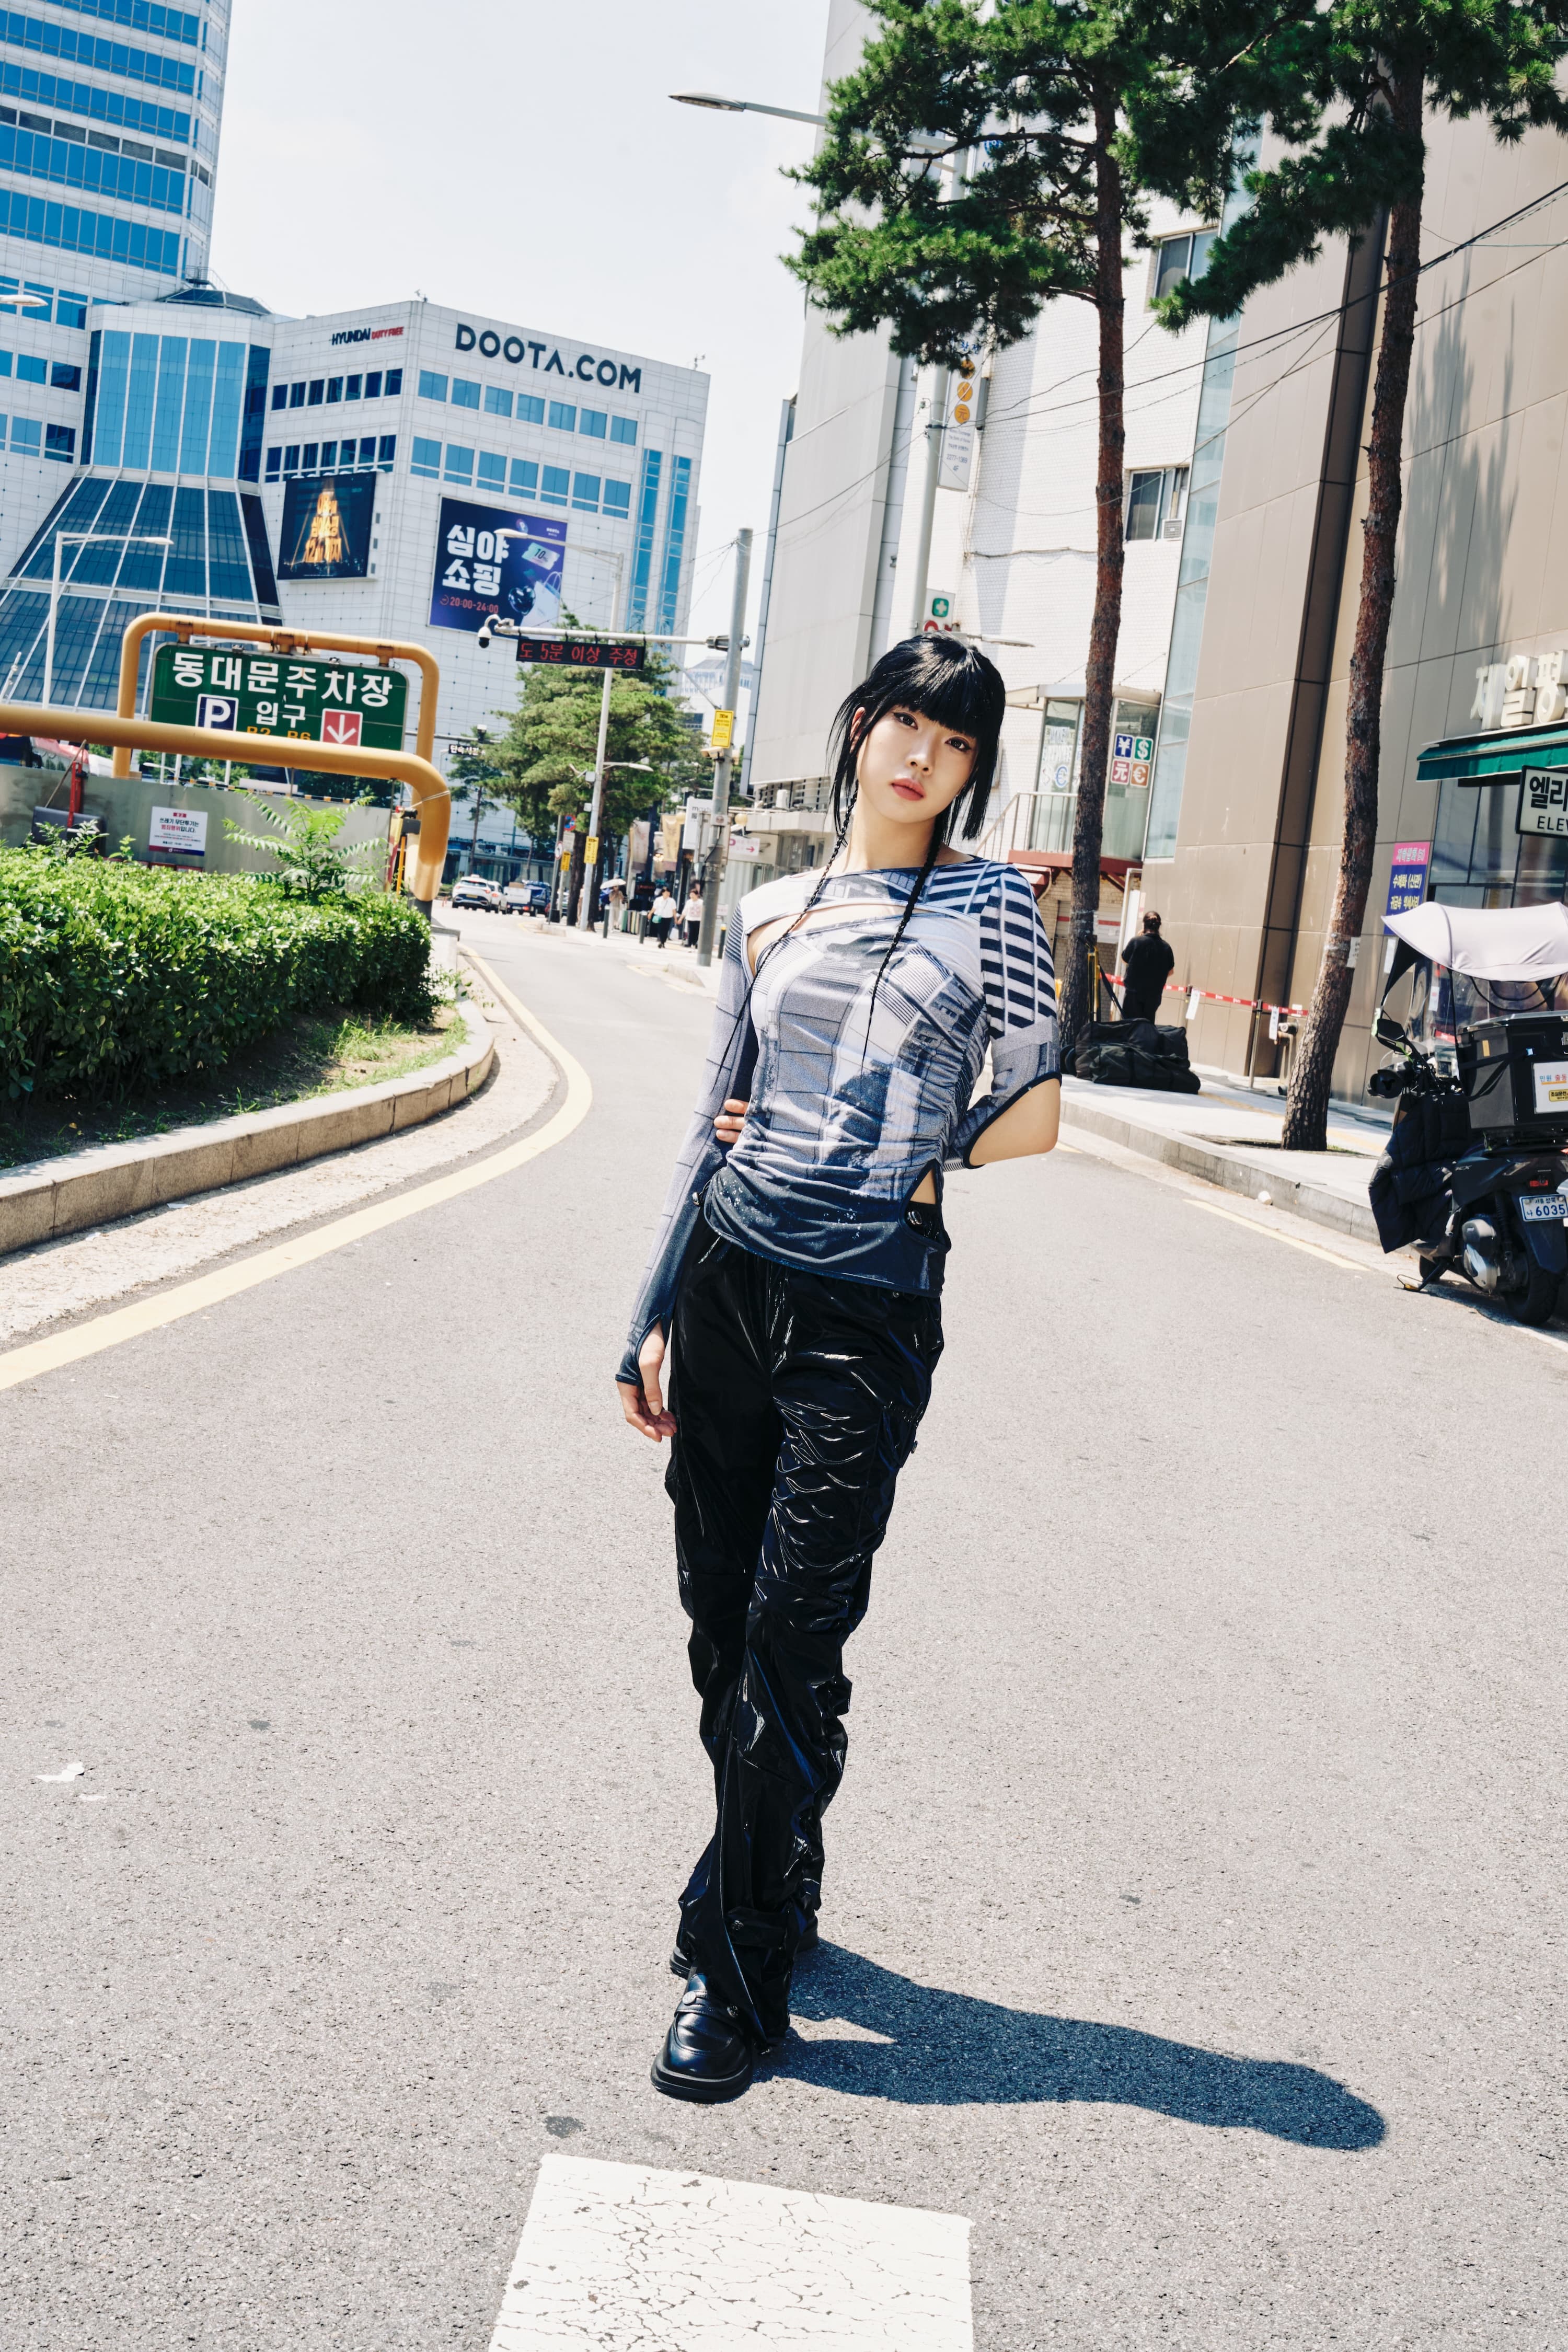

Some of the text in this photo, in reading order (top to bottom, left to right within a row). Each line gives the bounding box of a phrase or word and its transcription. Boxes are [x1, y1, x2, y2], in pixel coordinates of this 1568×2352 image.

[331, 326, 404, 345] HYUNDAI DUTY FREE
[455, 323, 642, 394] DOOTA.COM
[447, 524, 510, 563] 심야
[442, 559, 502, 596] 쇼핑
[450, 596, 499, 614] 20:00-24:00
[540, 643, 563, 661] 5분
[571, 645, 600, 664] 이상
[609, 648, 638, 666] 주정
[172, 652, 393, 707] 동대문주차장
[1470, 649, 1568, 730] 제일평
[203, 698, 231, 728] P
[256, 701, 306, 728] 입구
[1113, 763, 1128, 780] 元
[1537, 815, 1568, 832] ELE
[1536, 1204, 1565, 1216] 6035
